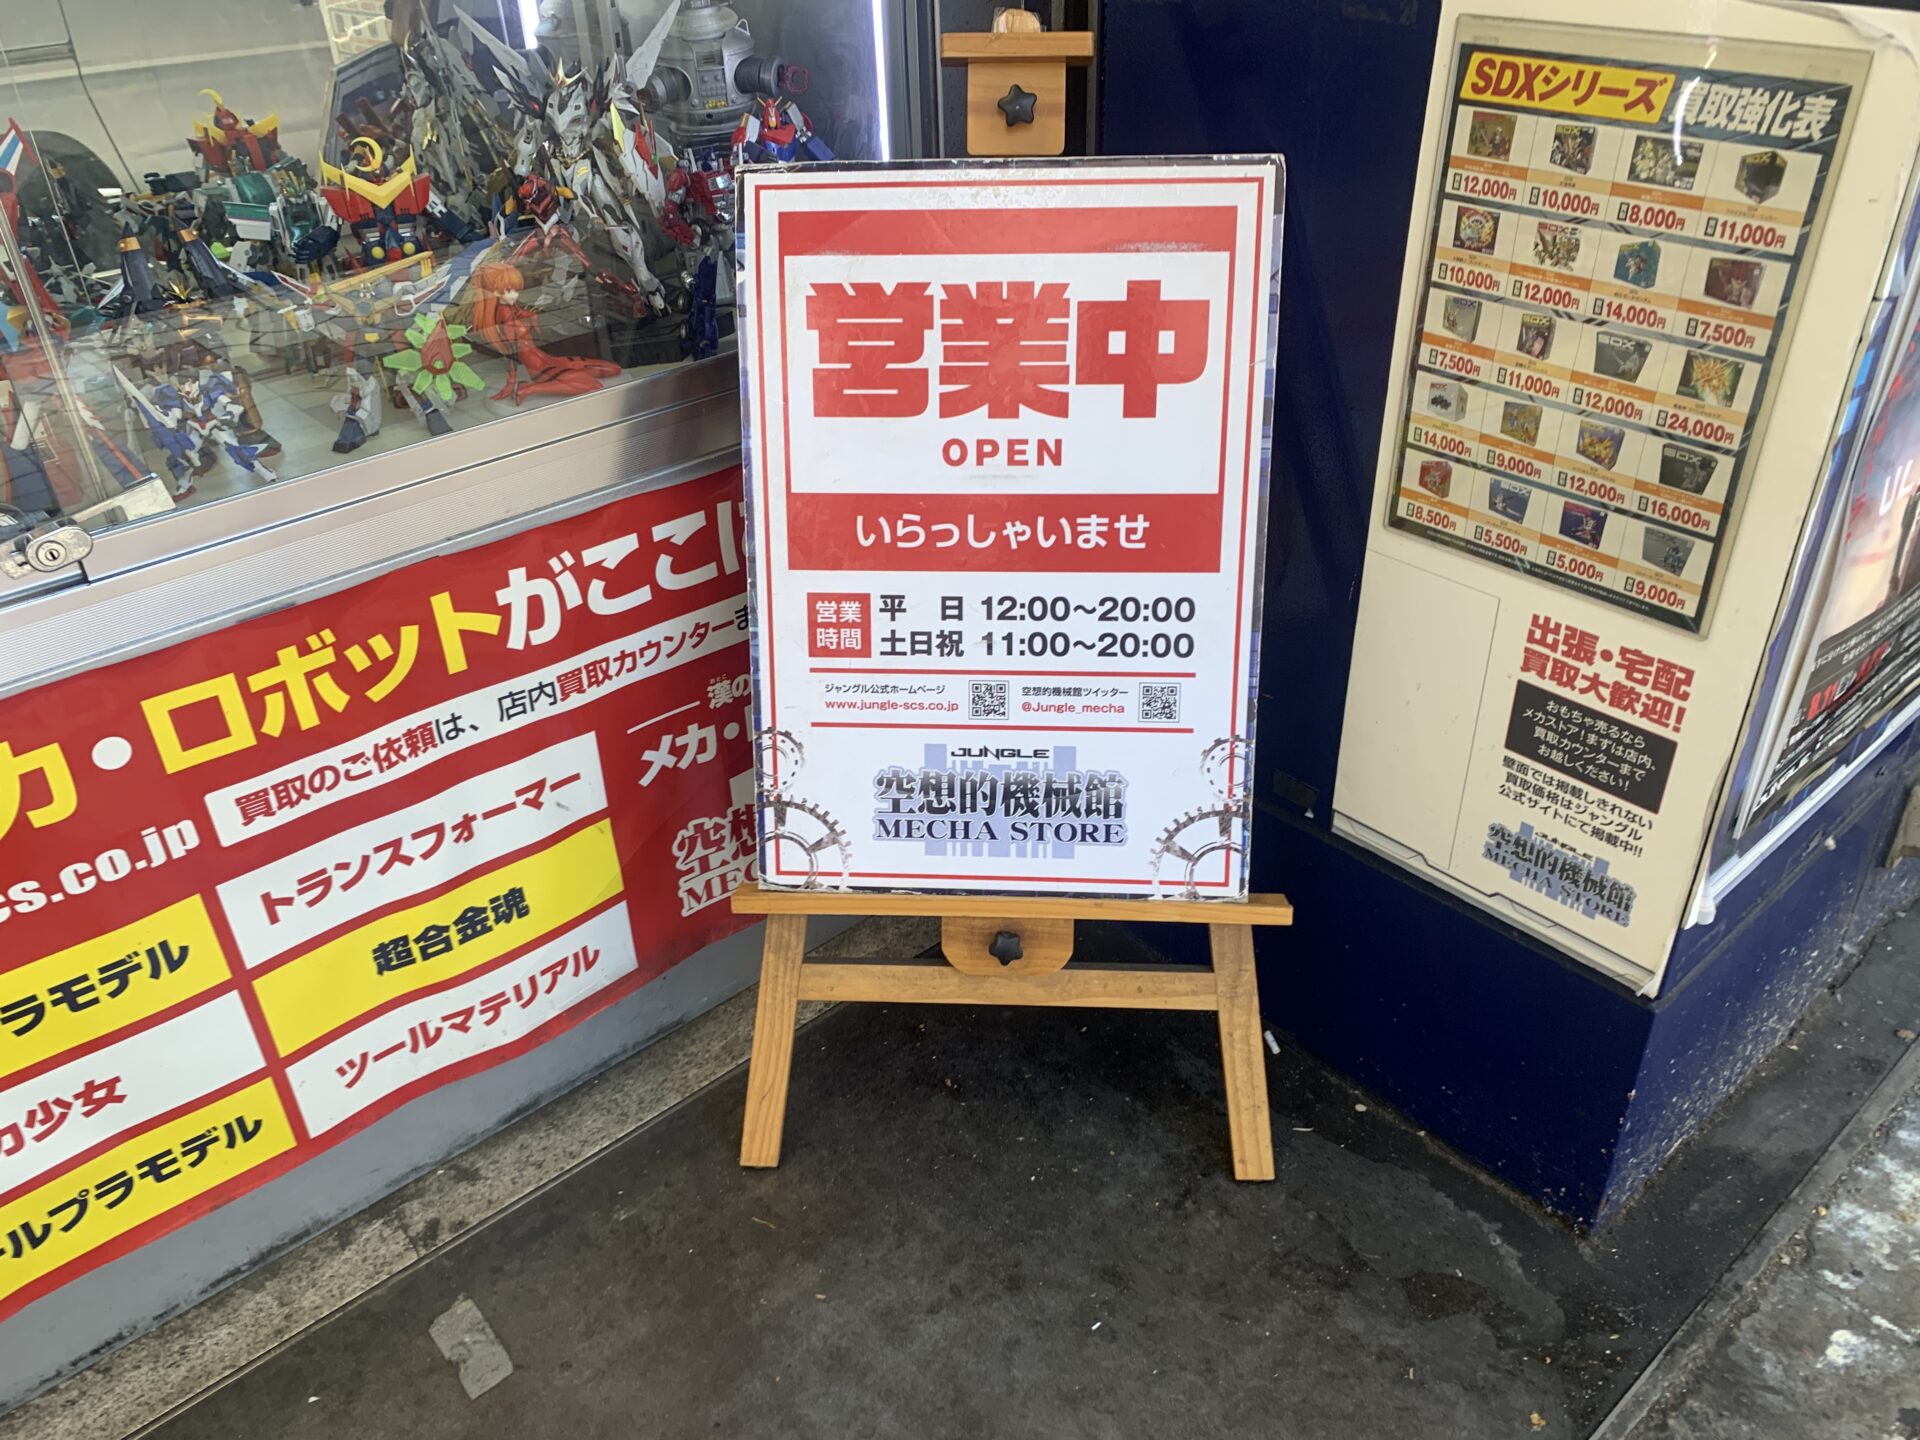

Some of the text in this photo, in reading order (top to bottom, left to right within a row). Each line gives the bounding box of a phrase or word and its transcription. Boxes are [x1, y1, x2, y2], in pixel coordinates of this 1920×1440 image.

[1471, 58, 1668, 115] SDXシリーズ
[1668, 80, 1838, 141] 買取強化表
[1463, 175, 1517, 200] 12,000円
[1542, 190, 1599, 216] 10,000円
[1629, 204, 1686, 231] 8,000円
[1720, 220, 1787, 249] 11,000円
[1450, 266, 1500, 292] 10,000円
[1524, 283, 1580, 310] 12,000円
[1606, 301, 1666, 329] 14,000円
[1700, 321, 1755, 348] 7,500円
[806, 279, 1211, 420] 営業中
[1439, 352, 1481, 376] 7,500円
[1508, 370, 1560, 398] 11,000円
[1585, 391, 1643, 421] 12,000円
[1667, 413, 1735, 444] 24,000円
[942, 438, 1064, 468] OPEN
[1423, 430, 1472, 457] 14,000円
[1496, 453, 1542, 479] 9,000円
[1569, 475, 1625, 504] 12,000円
[1415, 506, 1457, 531] 8,500円
[1650, 500, 1711, 531] 16,000円
[856, 514, 1151, 551] いらっしゃいませ
[1483, 530, 1528, 555] 5,500円
[1556, 554, 1604, 582] 5,000円
[981, 595, 1196, 622] 12:00～20:00
[1635, 580, 1686, 610] 9,000円
[816, 600, 862, 624] 営業
[816, 628, 862, 650] 時間
[880, 630, 1195, 658] 土日祝 11:00～20:00
[0, 500, 747, 841] カ・ロボットがここ
[1526, 613, 1695, 702] 出張・宅配
[824, 683, 946, 695] ジャングル公式ホームページ
[1021, 686, 1129, 698] 空想的機械館ツイッター
[1520, 646, 1687, 734] 買取大歓迎!
[824, 699, 959, 713] www.jungle-scs.co.jp
[1021, 702, 1125, 715] @Jungle_mecha
[1546, 700, 1646, 749] おもちゃ売るなら
[638, 705, 753, 787] メカ・
[951, 745, 1050, 761] JUNGLE
[1523, 708, 1657, 771] メカストア!まずは店内、
[1534, 726, 1647, 782] 買取カウンターまで
[1538, 744, 1630, 791] お越しください!
[876, 768, 1125, 820] 空想的機械館
[1502, 755, 1654, 831] 壁面では掲載しきれない
[1505, 771, 1643, 841] 買取価格はジャングル
[876, 818, 1125, 844] MECHA STORE
[1498, 784, 1644, 857] 公式サイトにて掲載中!!
[260, 772, 583, 926] トランスフォーマー
[371, 885, 530, 977] 超合金魂
[335, 943, 601, 1090] ツールマテリアル
[0, 1115, 264, 1260] ルプラモデル
